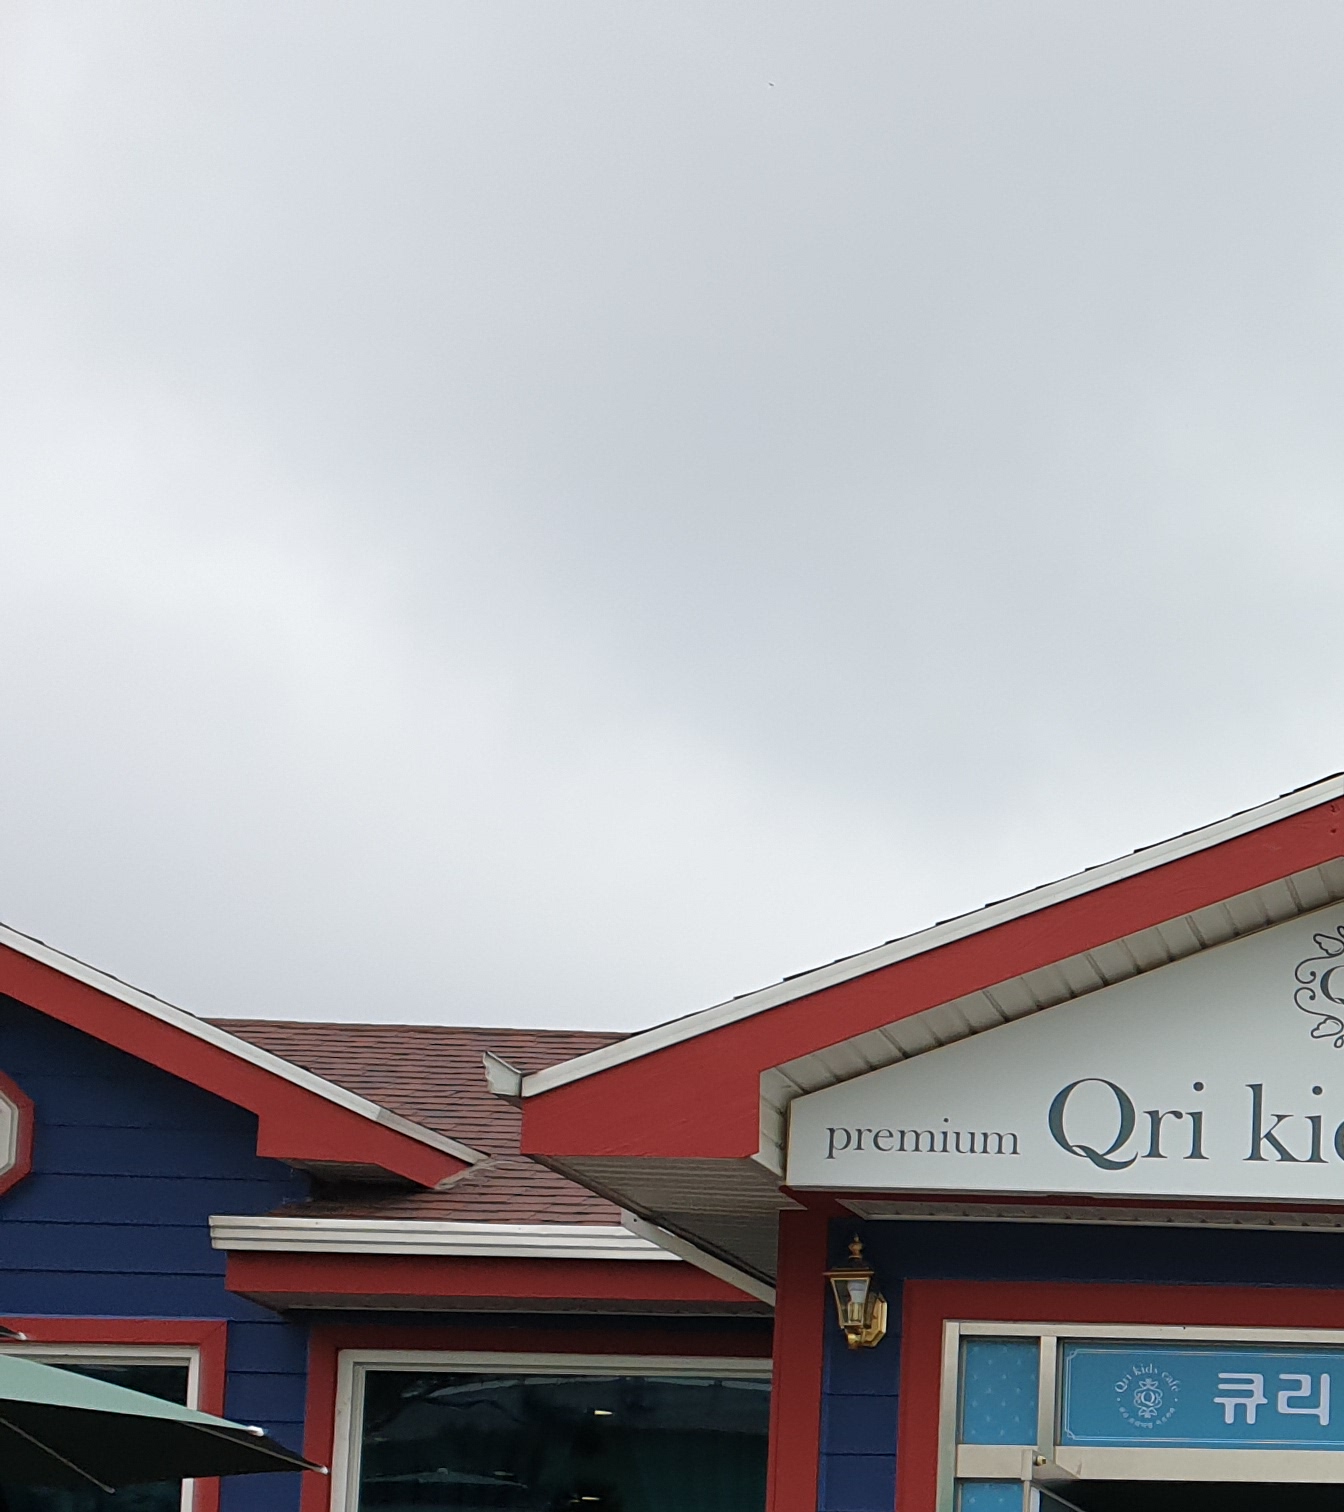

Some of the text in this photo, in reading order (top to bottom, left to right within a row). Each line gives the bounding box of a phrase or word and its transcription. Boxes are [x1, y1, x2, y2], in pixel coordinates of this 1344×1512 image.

[825, 1117, 1021, 1159] premium
[1047, 1077, 1210, 1171] Qri
[1133, 1363, 1158, 1376] kids
[1161, 1372, 1181, 1392] cafe
[1141, 1391, 1155, 1406] Q
[1213, 1373, 1331, 1426] 큐리
